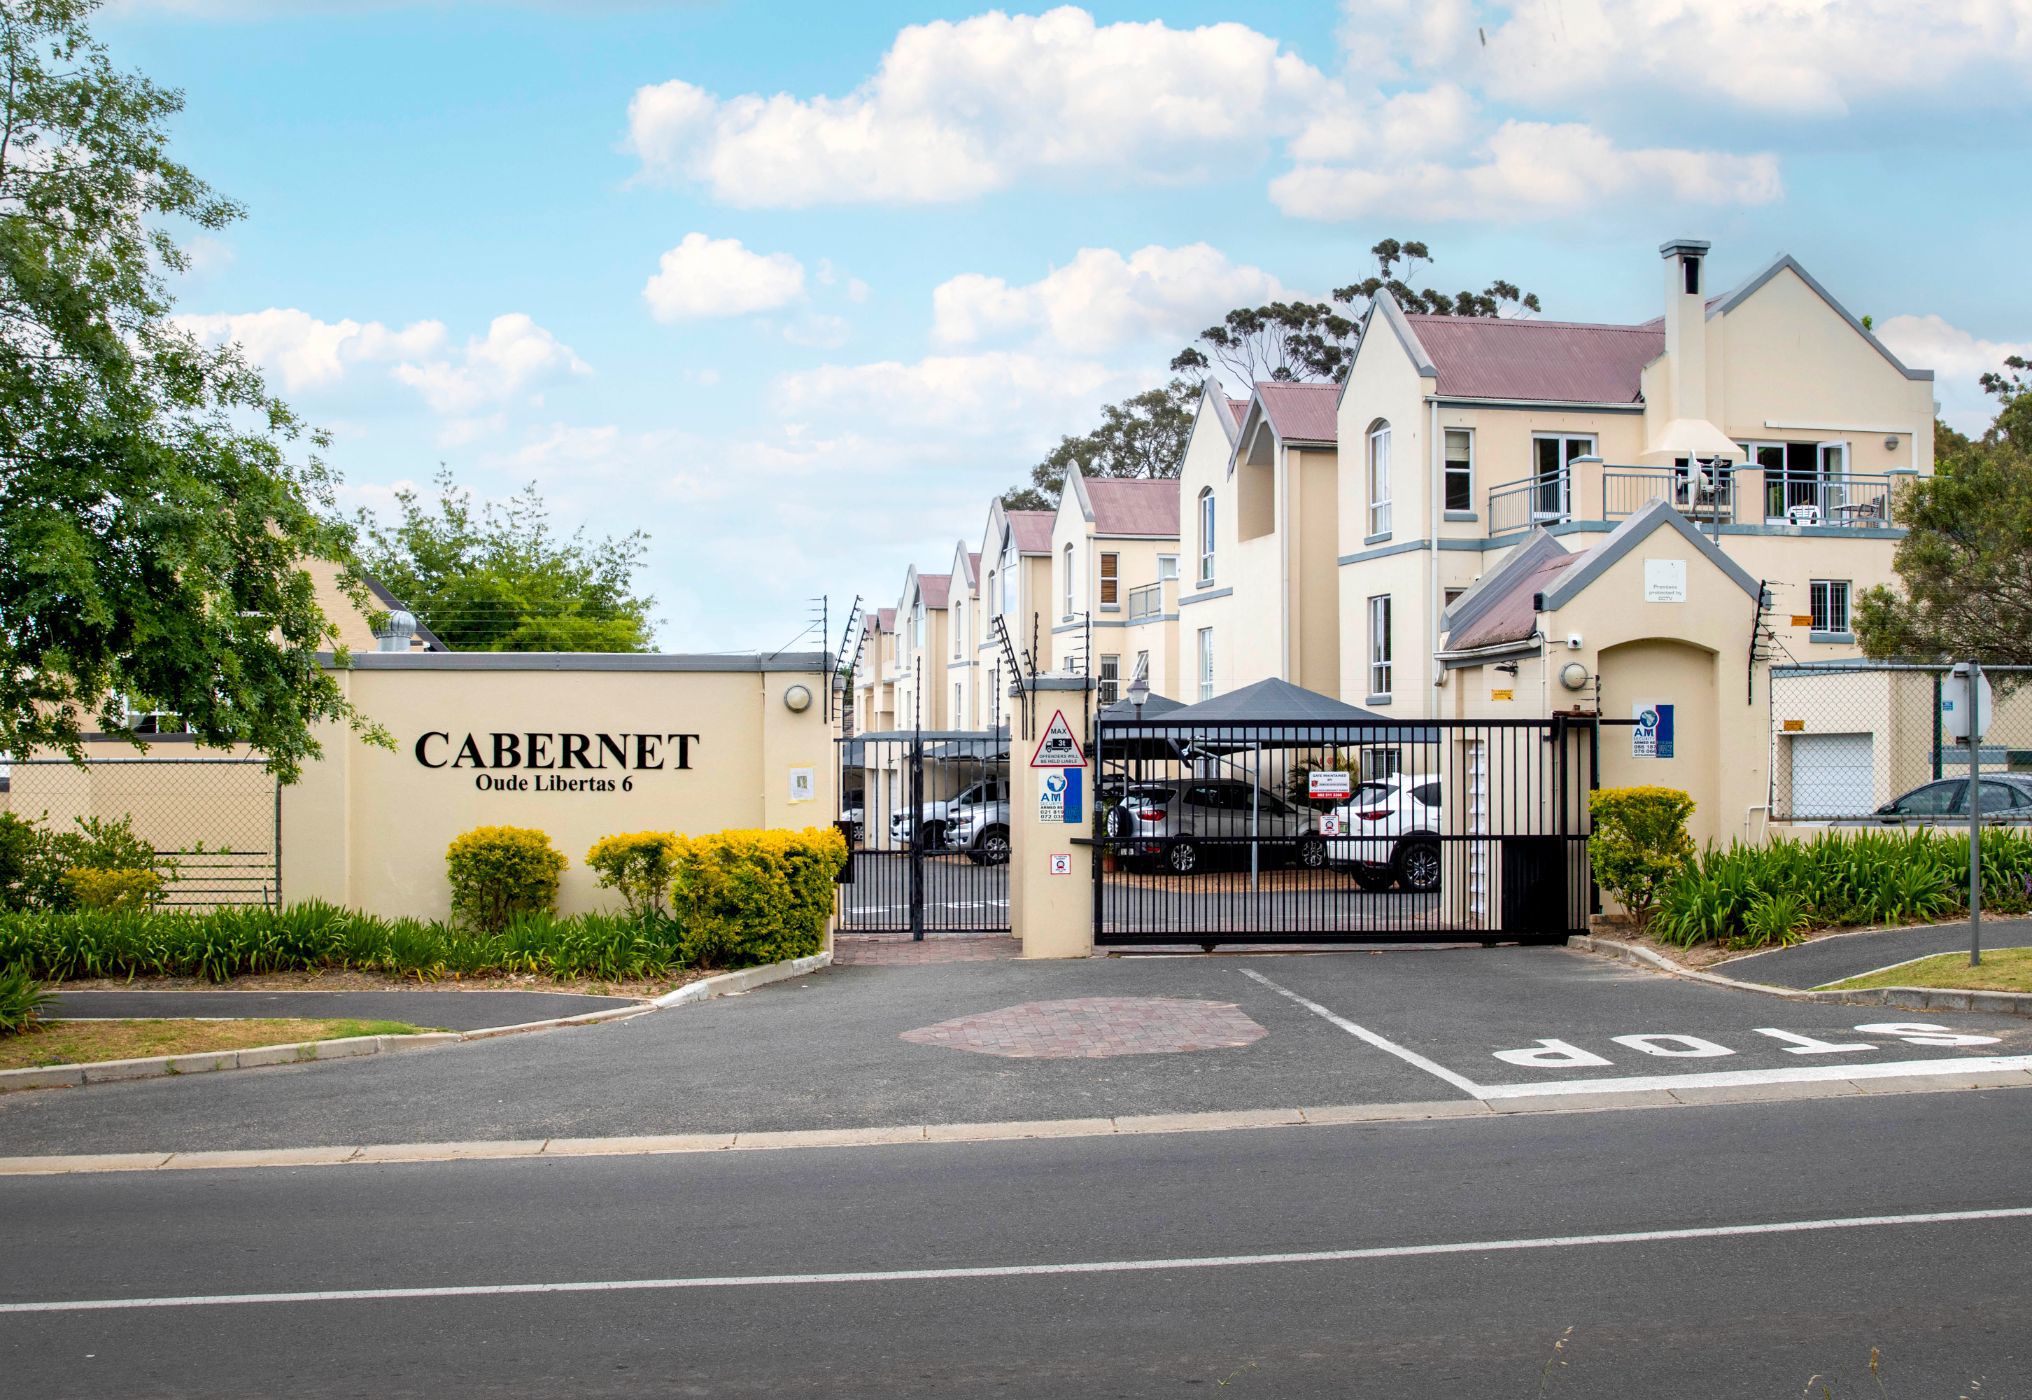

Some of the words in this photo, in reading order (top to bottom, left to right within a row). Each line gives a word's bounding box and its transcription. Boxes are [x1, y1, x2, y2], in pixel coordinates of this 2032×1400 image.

[1634, 728, 1654, 737] AM
[414, 731, 700, 771] CABERNET
[475, 773, 529, 792] Oude
[534, 773, 616, 792] Libertas
[621, 774, 633, 792] 6
[1040, 793, 1061, 802] AM
[1491, 1021, 2003, 1068] STOP
